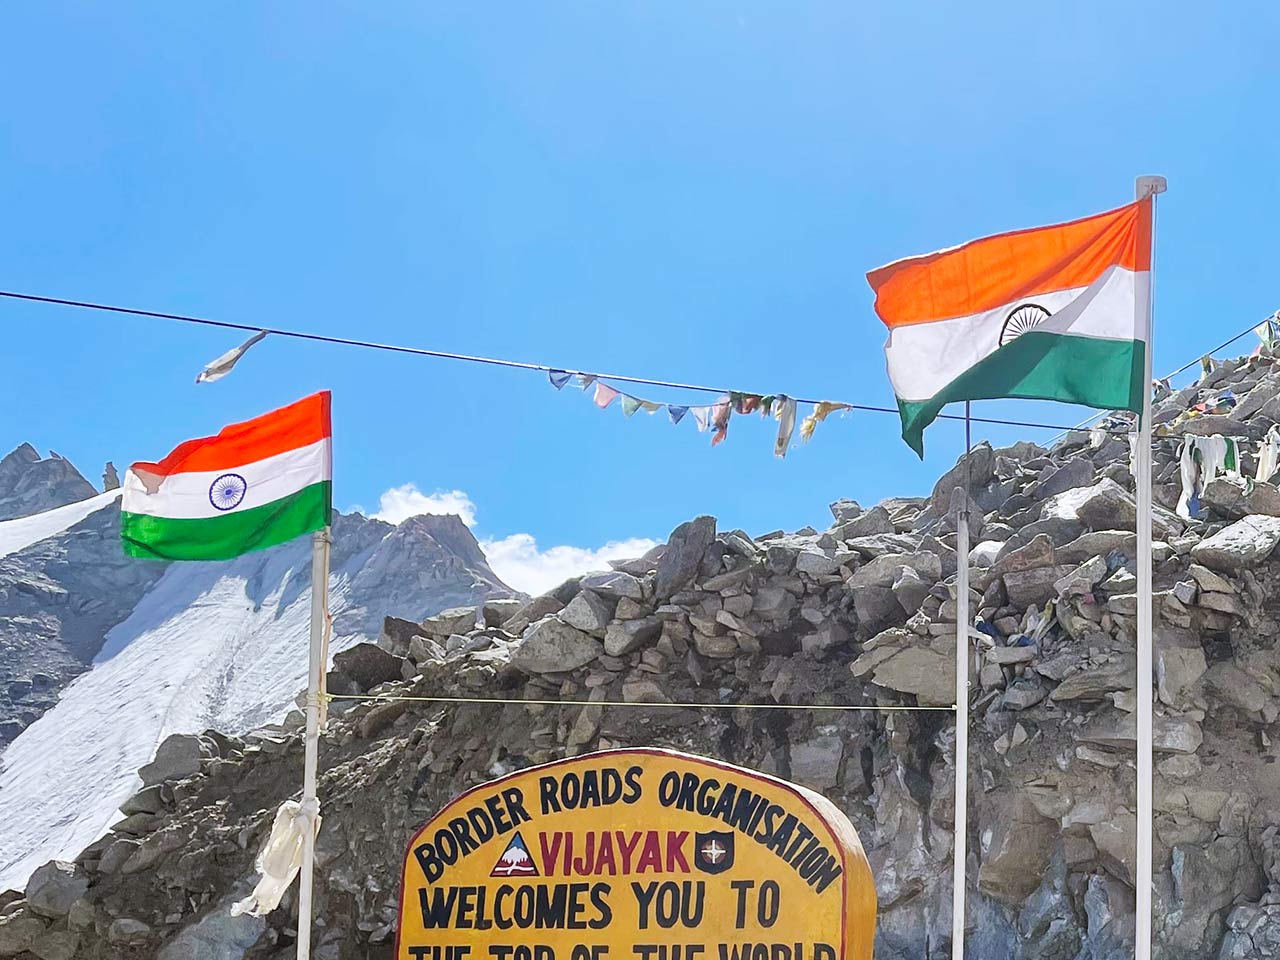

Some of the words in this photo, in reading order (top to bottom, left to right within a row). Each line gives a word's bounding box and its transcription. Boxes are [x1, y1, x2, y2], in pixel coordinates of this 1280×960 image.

[414, 787, 532, 884] BORDER
[539, 766, 642, 815] ROADS
[659, 771, 843, 893] ORGANISATION
[539, 831, 690, 876] VIJAYAK
[419, 880, 612, 930] WELCOMES
[631, 881, 705, 929] YOU
[731, 880, 780, 929] TO
